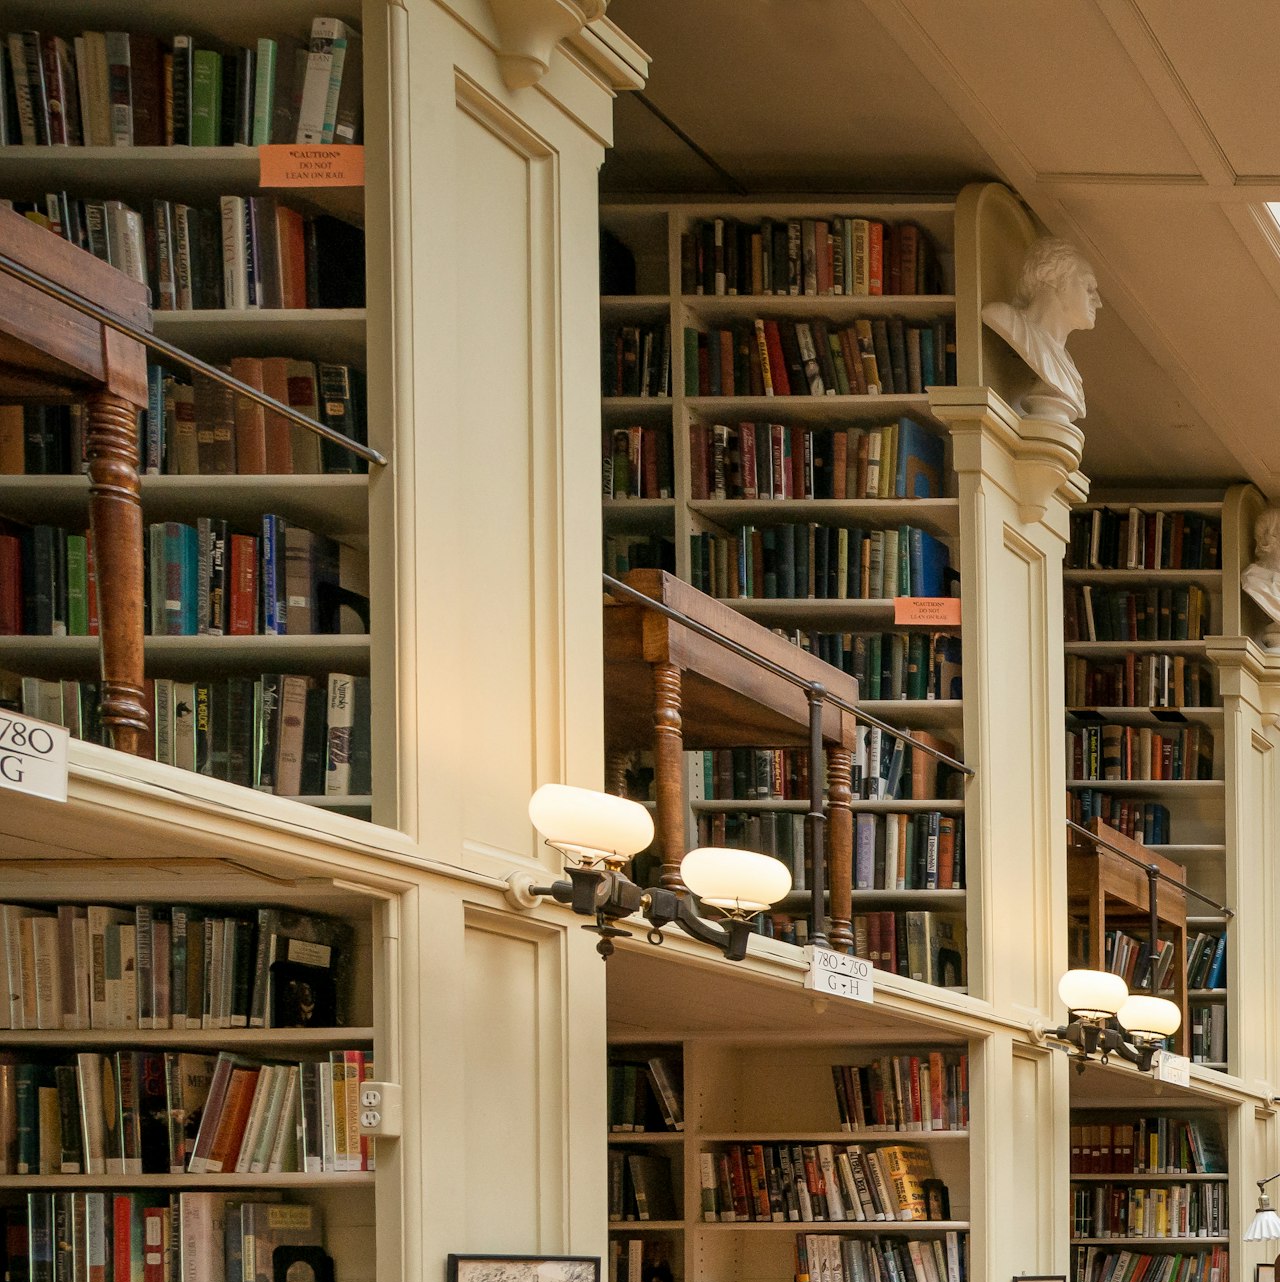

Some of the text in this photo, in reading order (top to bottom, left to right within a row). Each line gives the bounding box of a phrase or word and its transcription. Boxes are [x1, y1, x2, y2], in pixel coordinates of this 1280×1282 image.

[325, 171, 344, 179] RAIL
[177, 213, 187, 251] HAROLD
[198, 703, 208, 731] VERDICT
[0, 755, 23, 783] G
[818, 951, 868, 977] 780 750
[828, 975, 859, 995] G H
